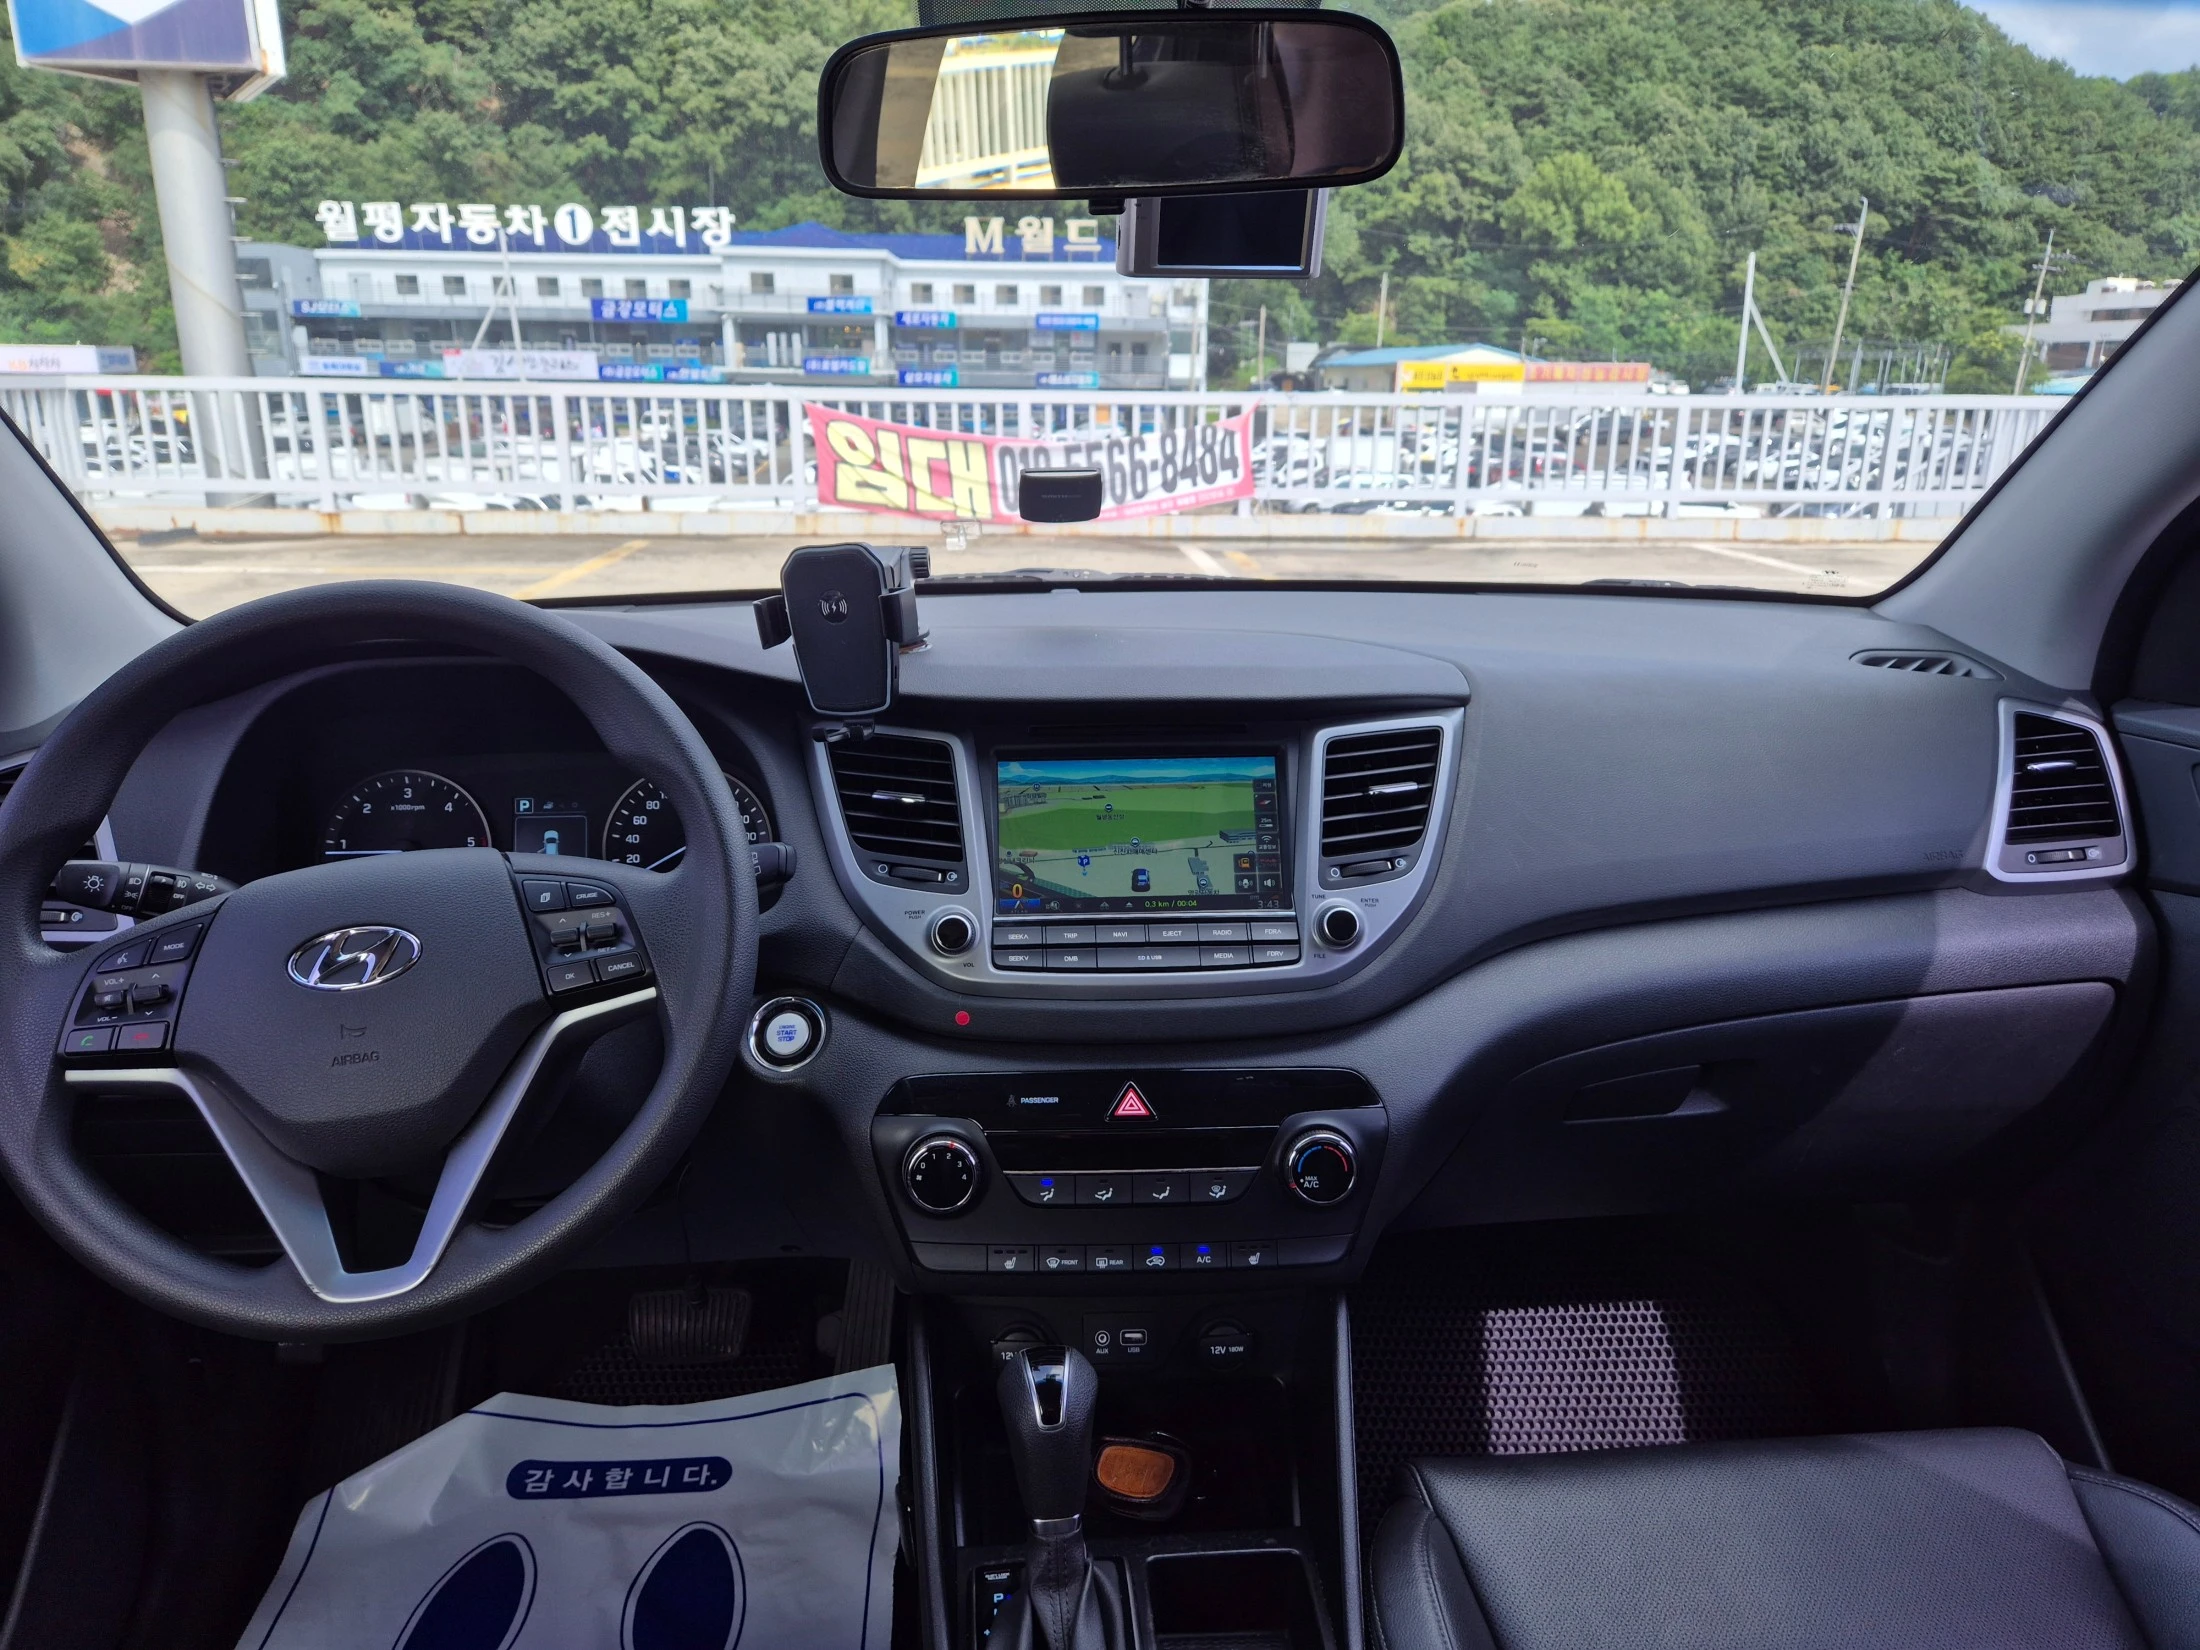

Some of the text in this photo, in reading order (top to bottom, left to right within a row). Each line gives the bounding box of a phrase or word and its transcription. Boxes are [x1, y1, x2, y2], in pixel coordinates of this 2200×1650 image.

[826, 419, 994, 520] 임대
[998, 422, 1240, 513] 0566-8484
[403, 788, 412, 799] 3
[362, 803, 372, 814] 2
[444, 802, 453, 812] 4
[519, 800, 530, 812] P
[646, 800, 660, 810] 80
[633, 815, 647, 825] 60
[467, 836, 476, 847] 5
[625, 834, 640, 844] 40
[340, 839, 347, 850] 1
[626, 853, 640, 864] 20
[173, 892, 185, 900] OFF
[576, 892, 598, 900] CRUISE
[1177, 899, 1198, 907] 00:04
[1258, 900, 1280, 909] 3:43
[163, 943, 185, 951] MODE
[1213, 952, 1234, 960] MEDIA
[607, 962, 635, 972] CANCEL
[565, 972, 575, 980] OK
[331, 1050, 380, 1068] AIRBAG
[1020, 1096, 1059, 1104] PASSENGER
[961, 1173, 967, 1181] 4
[1303, 1180, 1319, 1188] A/C
[1196, 1255, 1212, 1264] A/C
[1210, 1345, 1226, 1355] 12V
[525, 1463, 717, 1493] 감사합니다.
[993, 1592, 1004, 1603] P
